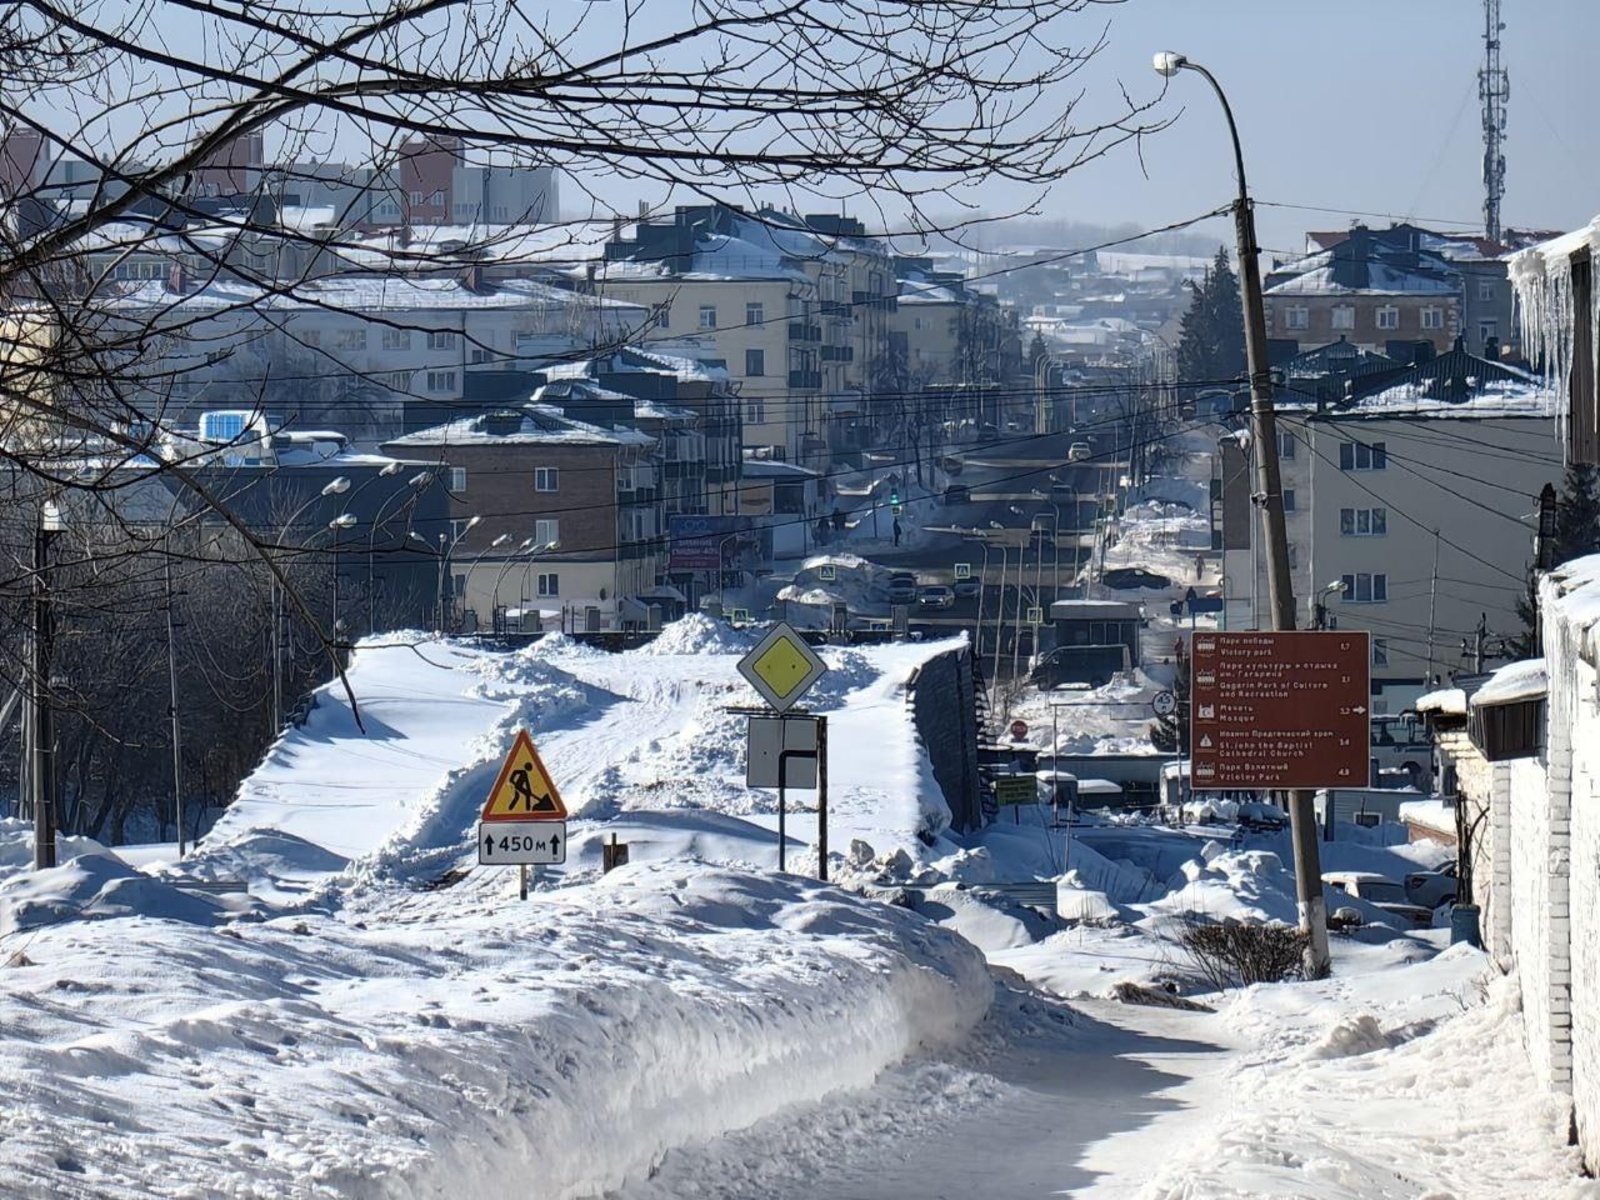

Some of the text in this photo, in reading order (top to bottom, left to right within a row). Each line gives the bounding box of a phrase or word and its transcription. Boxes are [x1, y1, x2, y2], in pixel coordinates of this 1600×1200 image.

[1220, 637, 1274, 645] Парк победы
[1221, 649, 1251, 657] Victory
[1220, 662, 1243, 670] Парк
[1220, 682, 1254, 690] Gagarin
